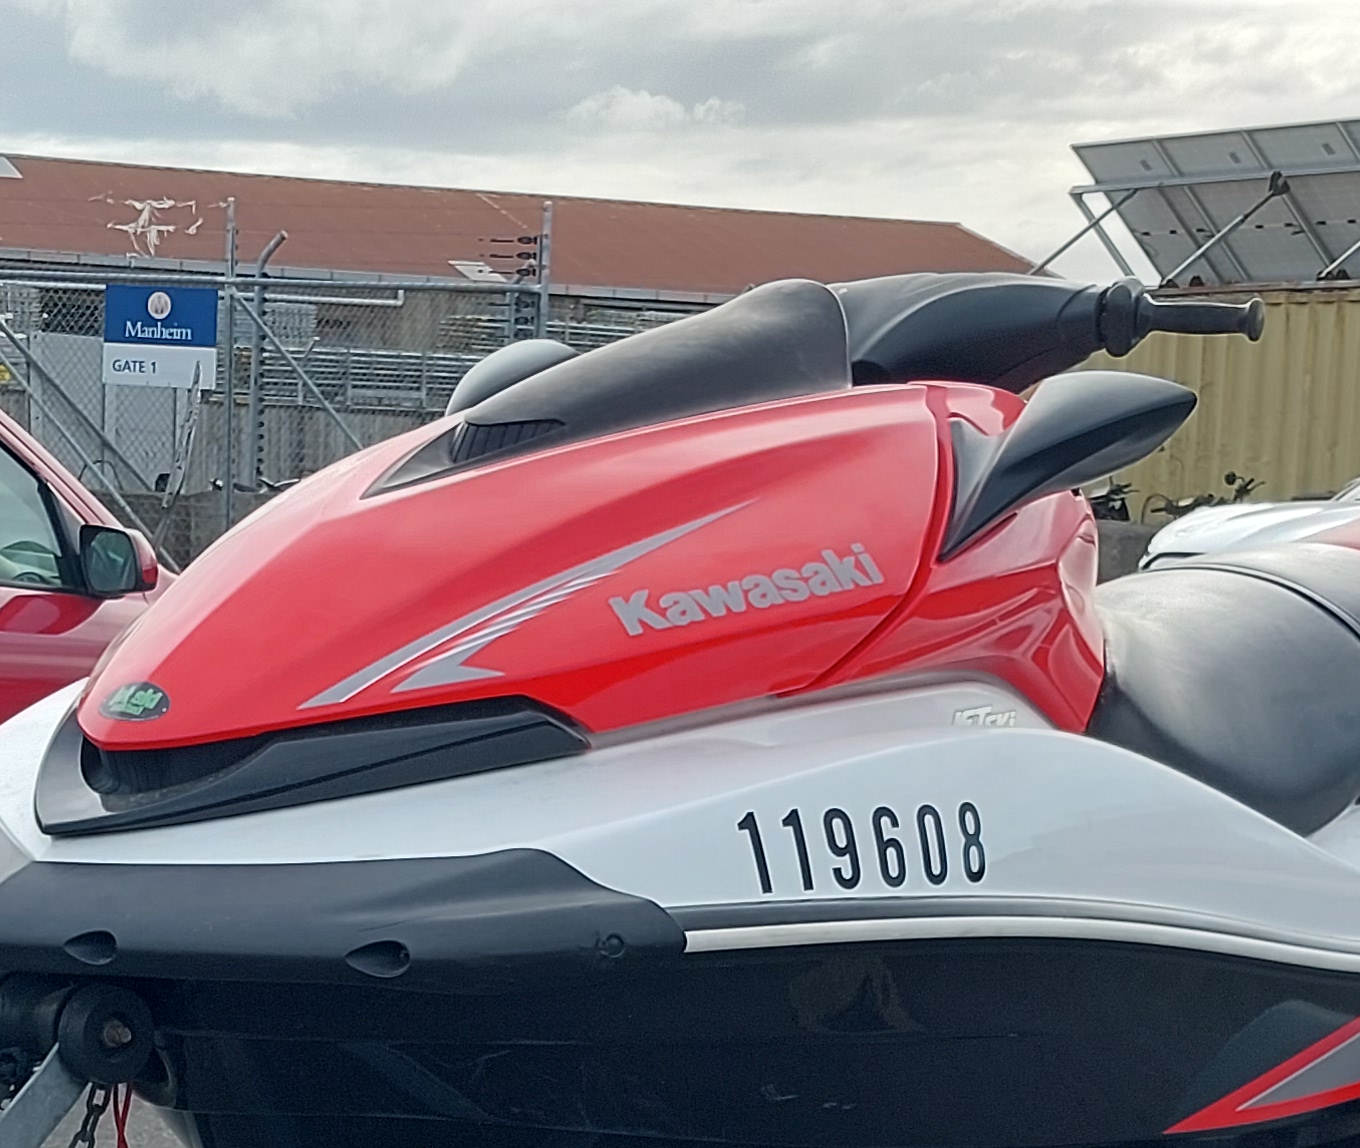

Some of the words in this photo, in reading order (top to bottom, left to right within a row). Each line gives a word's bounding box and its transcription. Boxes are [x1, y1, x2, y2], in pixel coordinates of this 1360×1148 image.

[124, 320, 192, 340] Manheim
[112, 359, 146, 374] GATE
[150, 361, 157, 374] 1
[608, 543, 884, 636] Kawasaki
[737, 801, 986, 894] 119608
